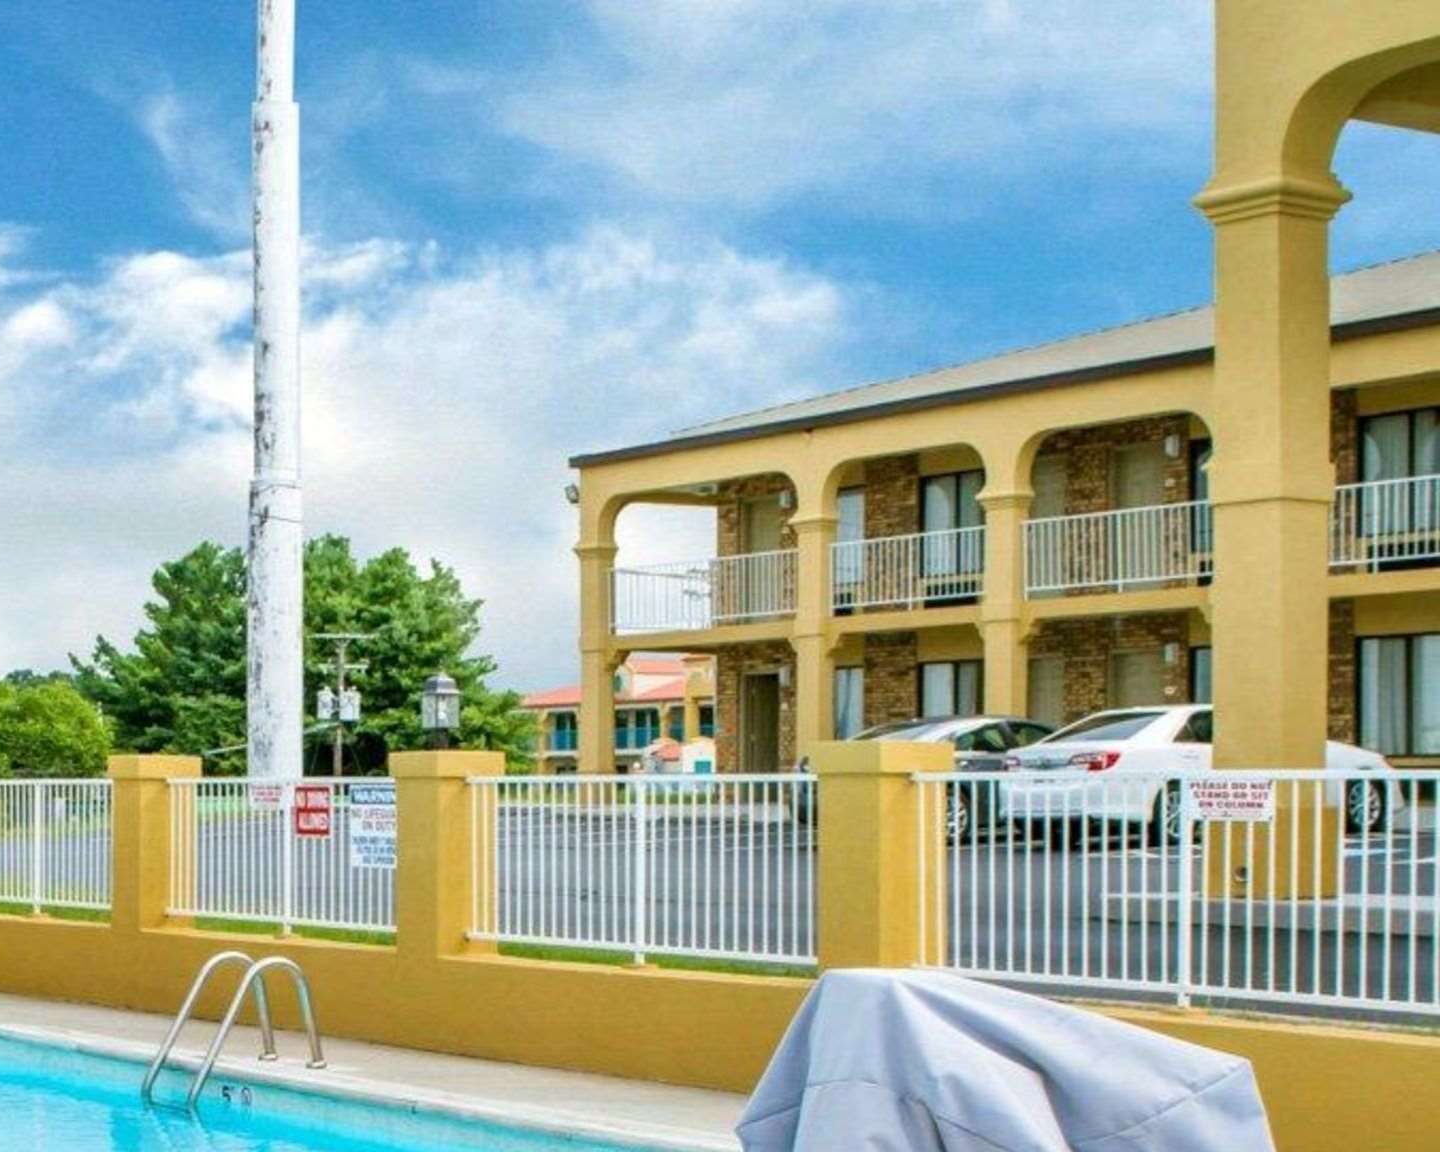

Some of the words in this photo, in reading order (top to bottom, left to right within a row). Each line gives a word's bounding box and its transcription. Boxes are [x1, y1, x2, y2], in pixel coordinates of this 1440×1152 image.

[1190, 782, 1228, 790] PLEASE
[1231, 782, 1247, 790] DO
[1250, 782, 1272, 790] NOT
[352, 791, 395, 804] WARNIN
[1193, 791, 1230, 800] STAND
